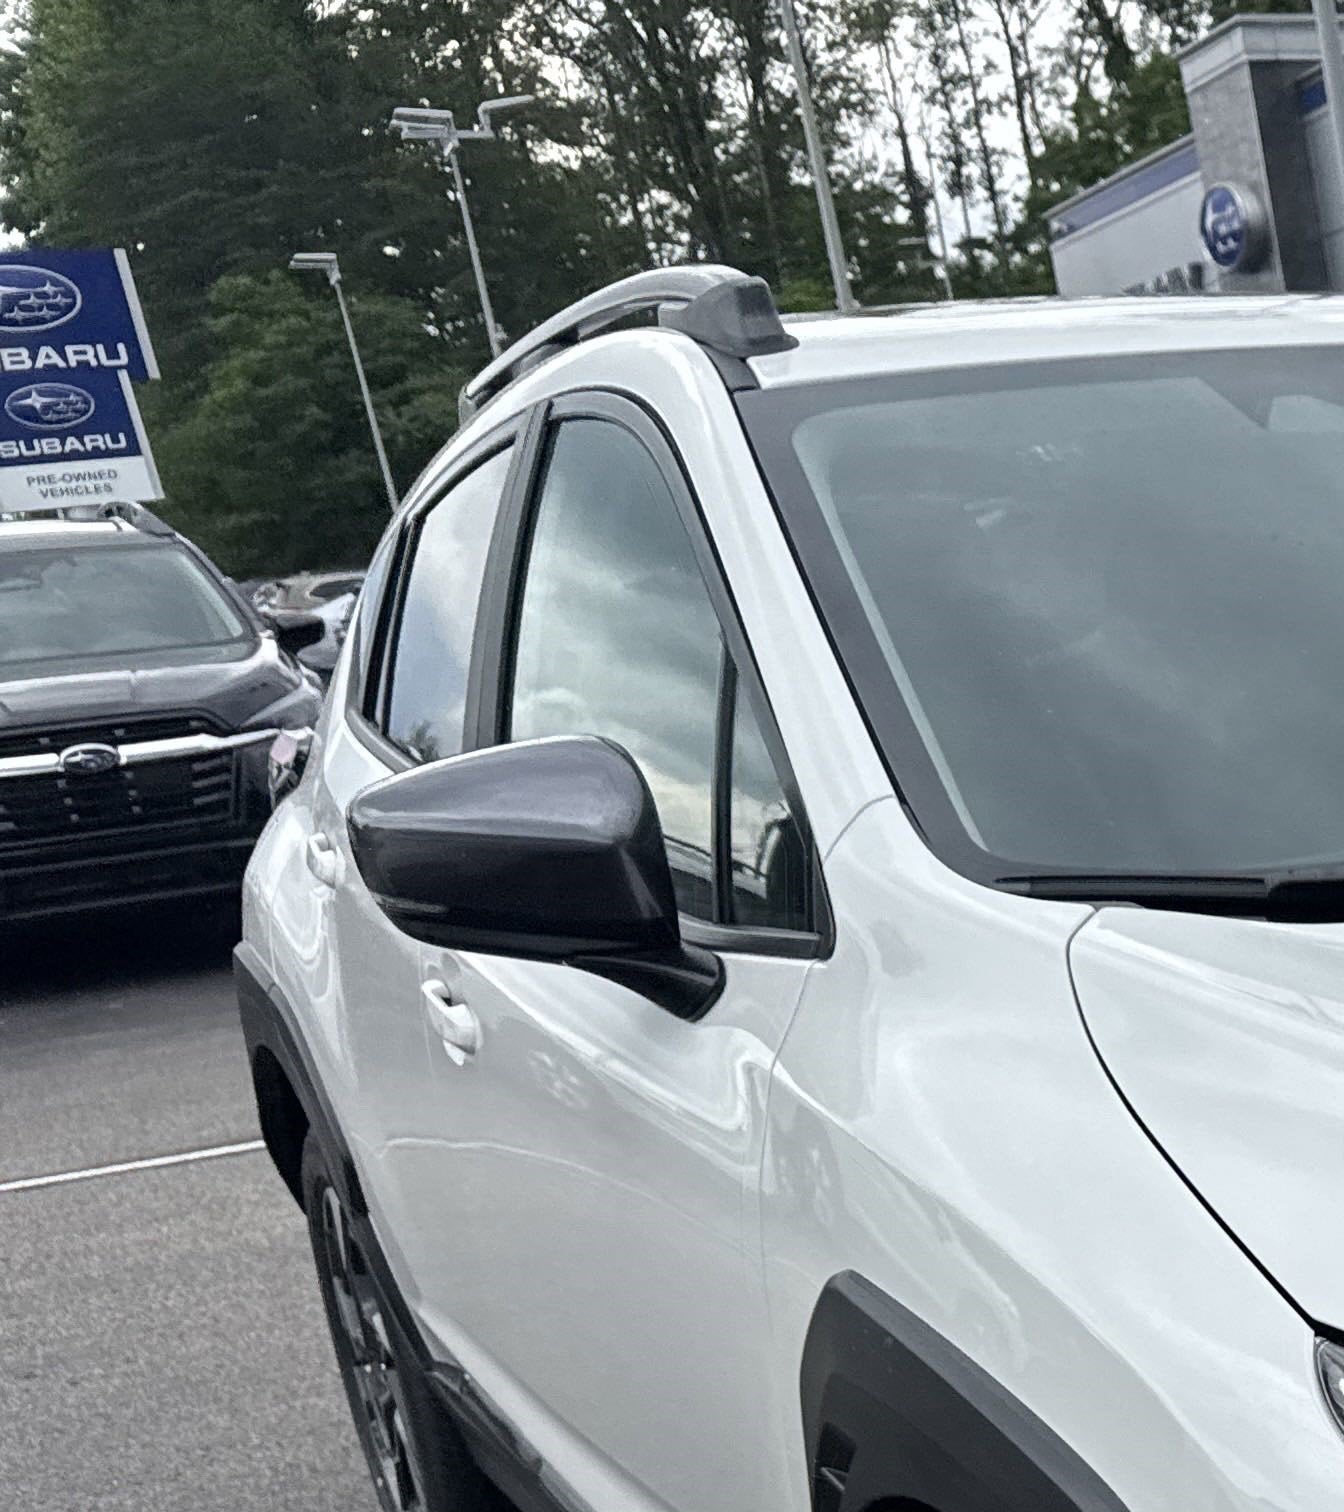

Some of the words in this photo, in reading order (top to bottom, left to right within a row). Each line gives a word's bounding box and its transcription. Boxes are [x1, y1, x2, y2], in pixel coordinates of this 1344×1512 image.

[0, 342, 129, 371] BARU
[0, 432, 127, 459] SUBARU
[26, 469, 118, 486] PRE-OWNED
[39, 483, 113, 499] VEHICLES
